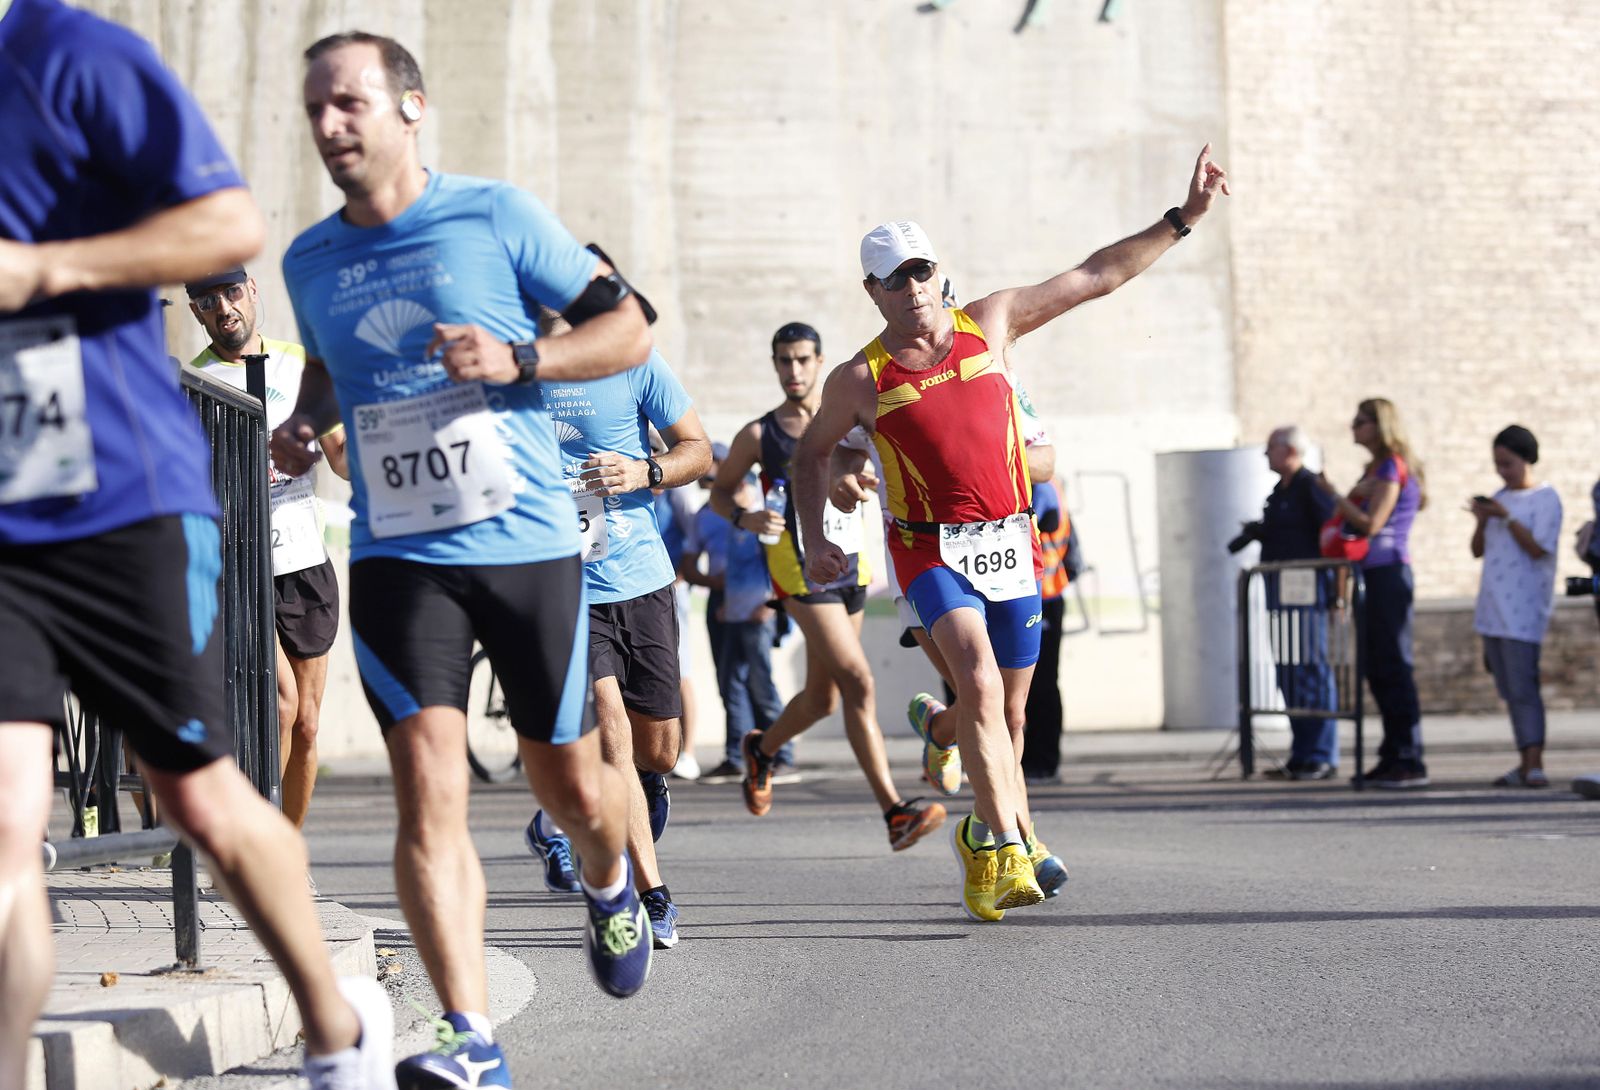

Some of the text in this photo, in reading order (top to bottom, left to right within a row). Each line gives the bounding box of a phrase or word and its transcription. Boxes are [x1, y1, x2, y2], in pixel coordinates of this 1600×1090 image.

[0, 391, 65, 438] 74
[554, 400, 592, 409] URBANA
[558, 408, 597, 418] MÁLAGA
[382, 440, 470, 488] 8707
[958, 548, 1017, 576] 1698
